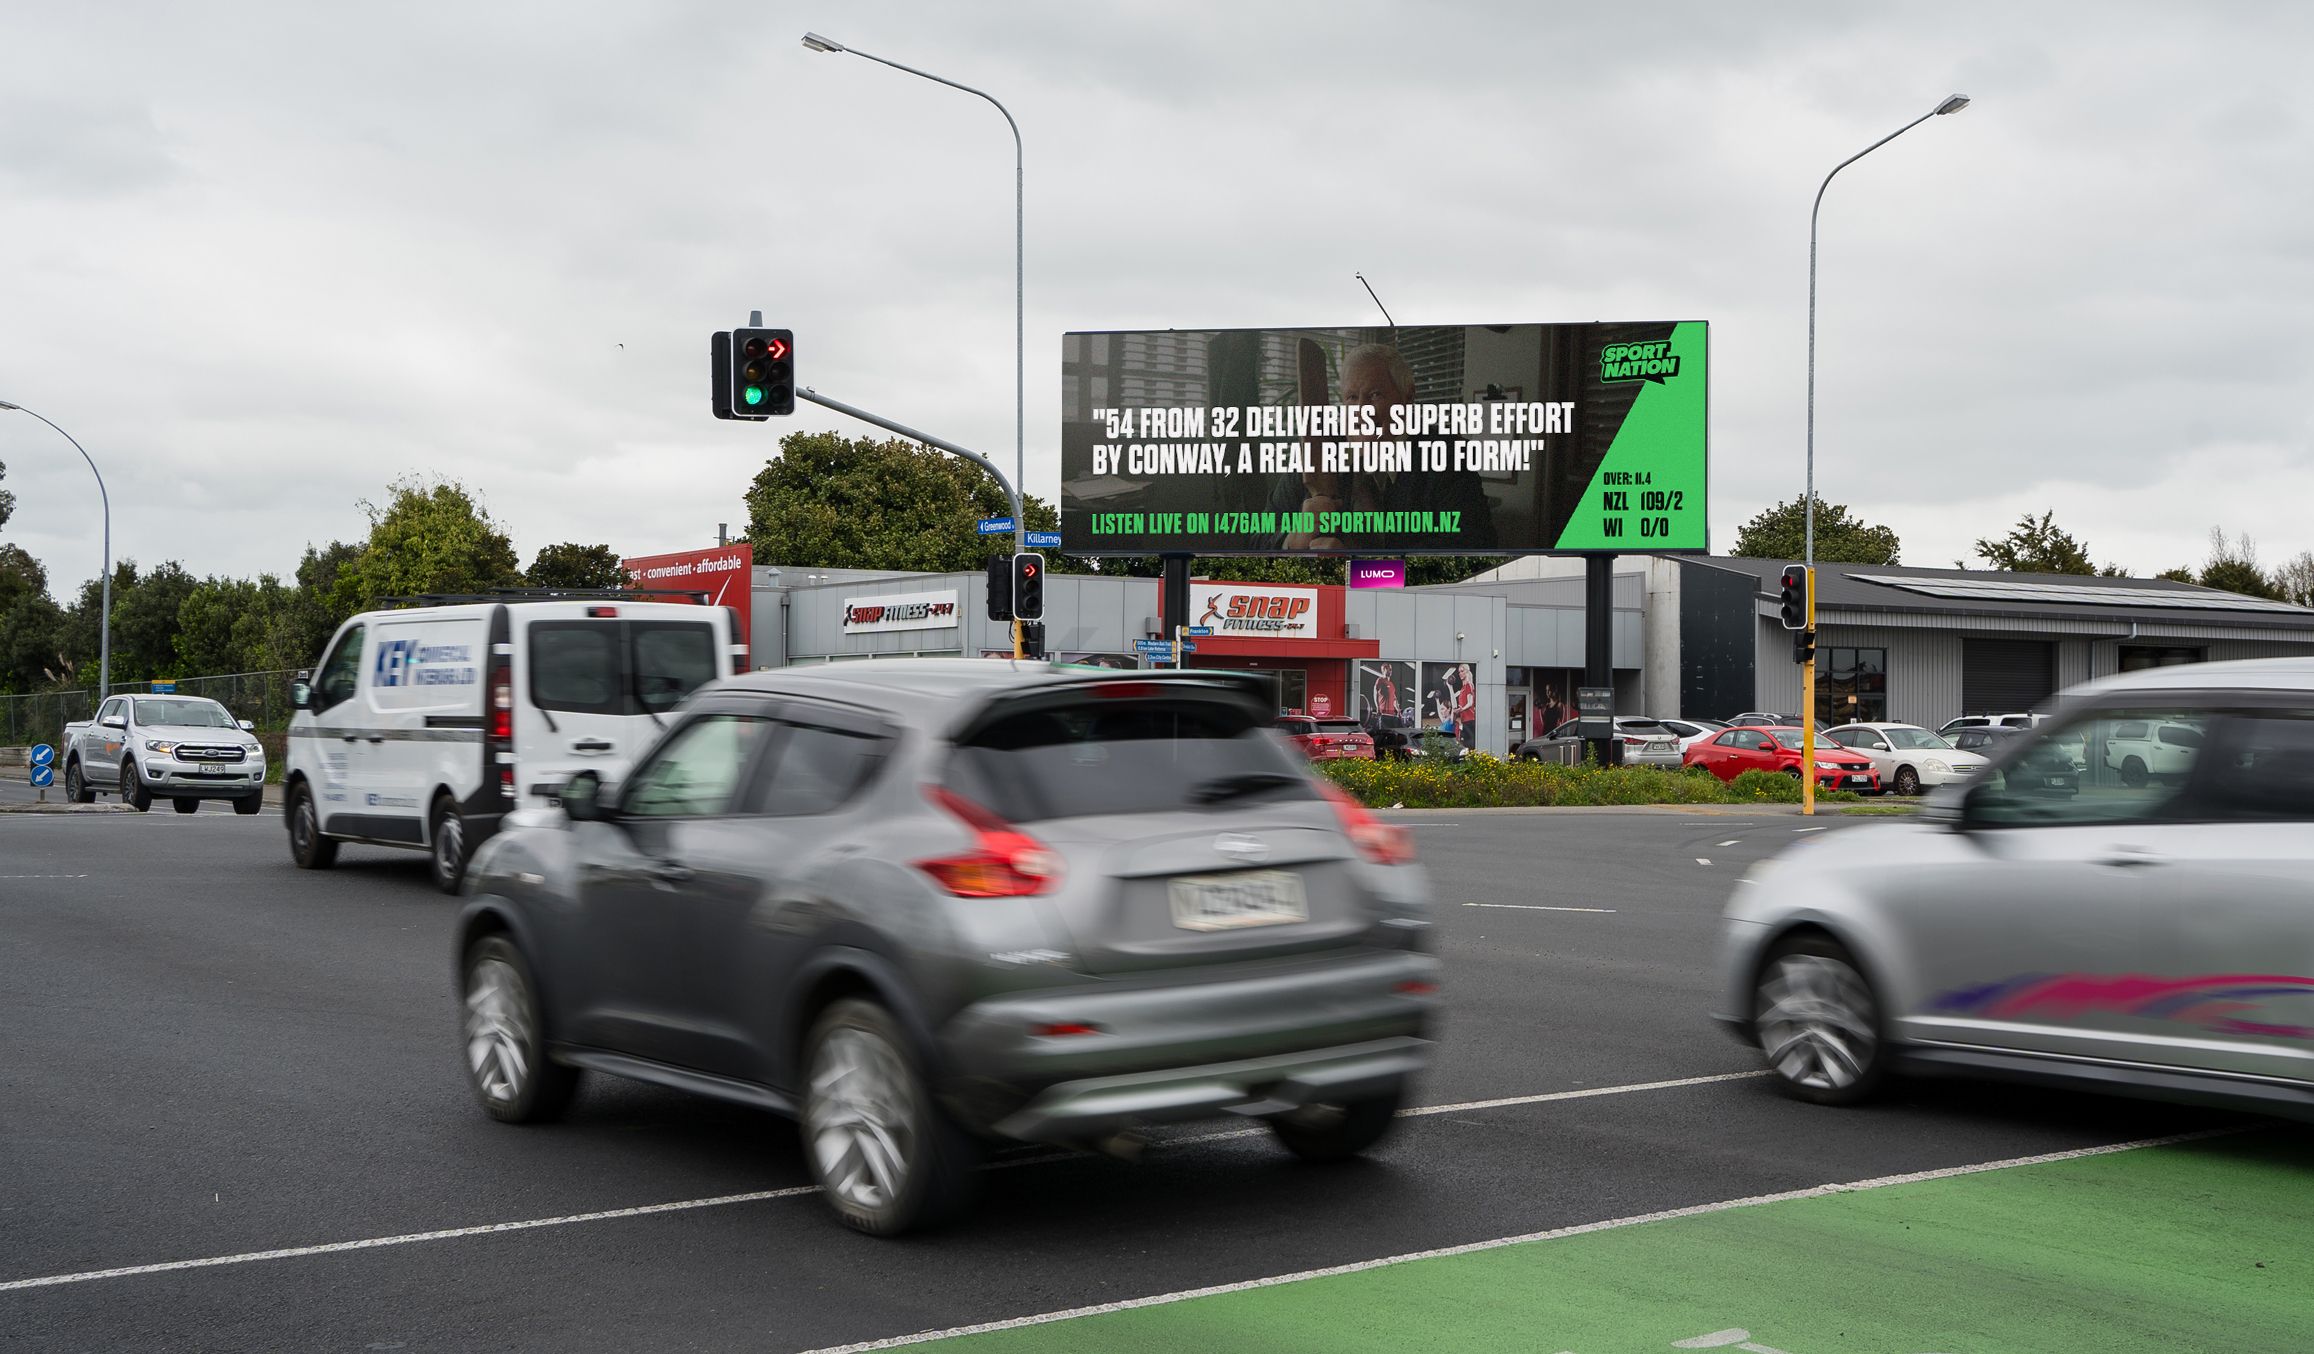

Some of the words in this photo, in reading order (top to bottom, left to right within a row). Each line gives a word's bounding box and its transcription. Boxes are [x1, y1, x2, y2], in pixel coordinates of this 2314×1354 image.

[1604, 344, 1667, 362] SPORT
[1604, 358, 1676, 378] NATION
[1093, 408, 1134, 438] "54
[1140, 407, 1204, 438] FROM
[1211, 407, 1239, 438] 32
[1246, 405, 1383, 439] DELIVERIES,
[1390, 403, 1483, 435] SUPERB
[1490, 402, 1575, 434] EFFORT
[1093, 444, 1123, 475] BY
[1128, 443, 1231, 477] CONWAY,
[1238, 443, 1253, 474] A
[1260, 442, 1315, 473] REAL
[1322, 441, 1412, 473] RETURN
[1418, 441, 1447, 472] TO
[1454, 439, 1545, 472] FORM!"
[1604, 472, 1632, 485] OVER:
[1635, 472, 1651, 485] 11.4
[1604, 491, 1629, 511] NZL
[1641, 491, 1683, 511] 109/2
[984, 520, 1011, 531] Greenwood
[1092, 513, 1144, 534] LISTEN
[1149, 513, 1182, 534] LIVE
[1187, 513, 1209, 534] ON
[1214, 512, 1276, 533] 1476AM
[1281, 512, 1314, 533] AND
[1319, 512, 1461, 533] SPORTNATION.NZ
[1604, 518, 1622, 537] WI
[1640, 517, 1669, 537] 0/0
[1027, 533, 1061, 545] Killarney
[628, 569, 640, 580] ast
[647, 562, 691, 579] convenient
[696, 555, 741, 574] affordable
[1361, 570, 1394, 578] LUMO
[374, 640, 418, 687] KEY
